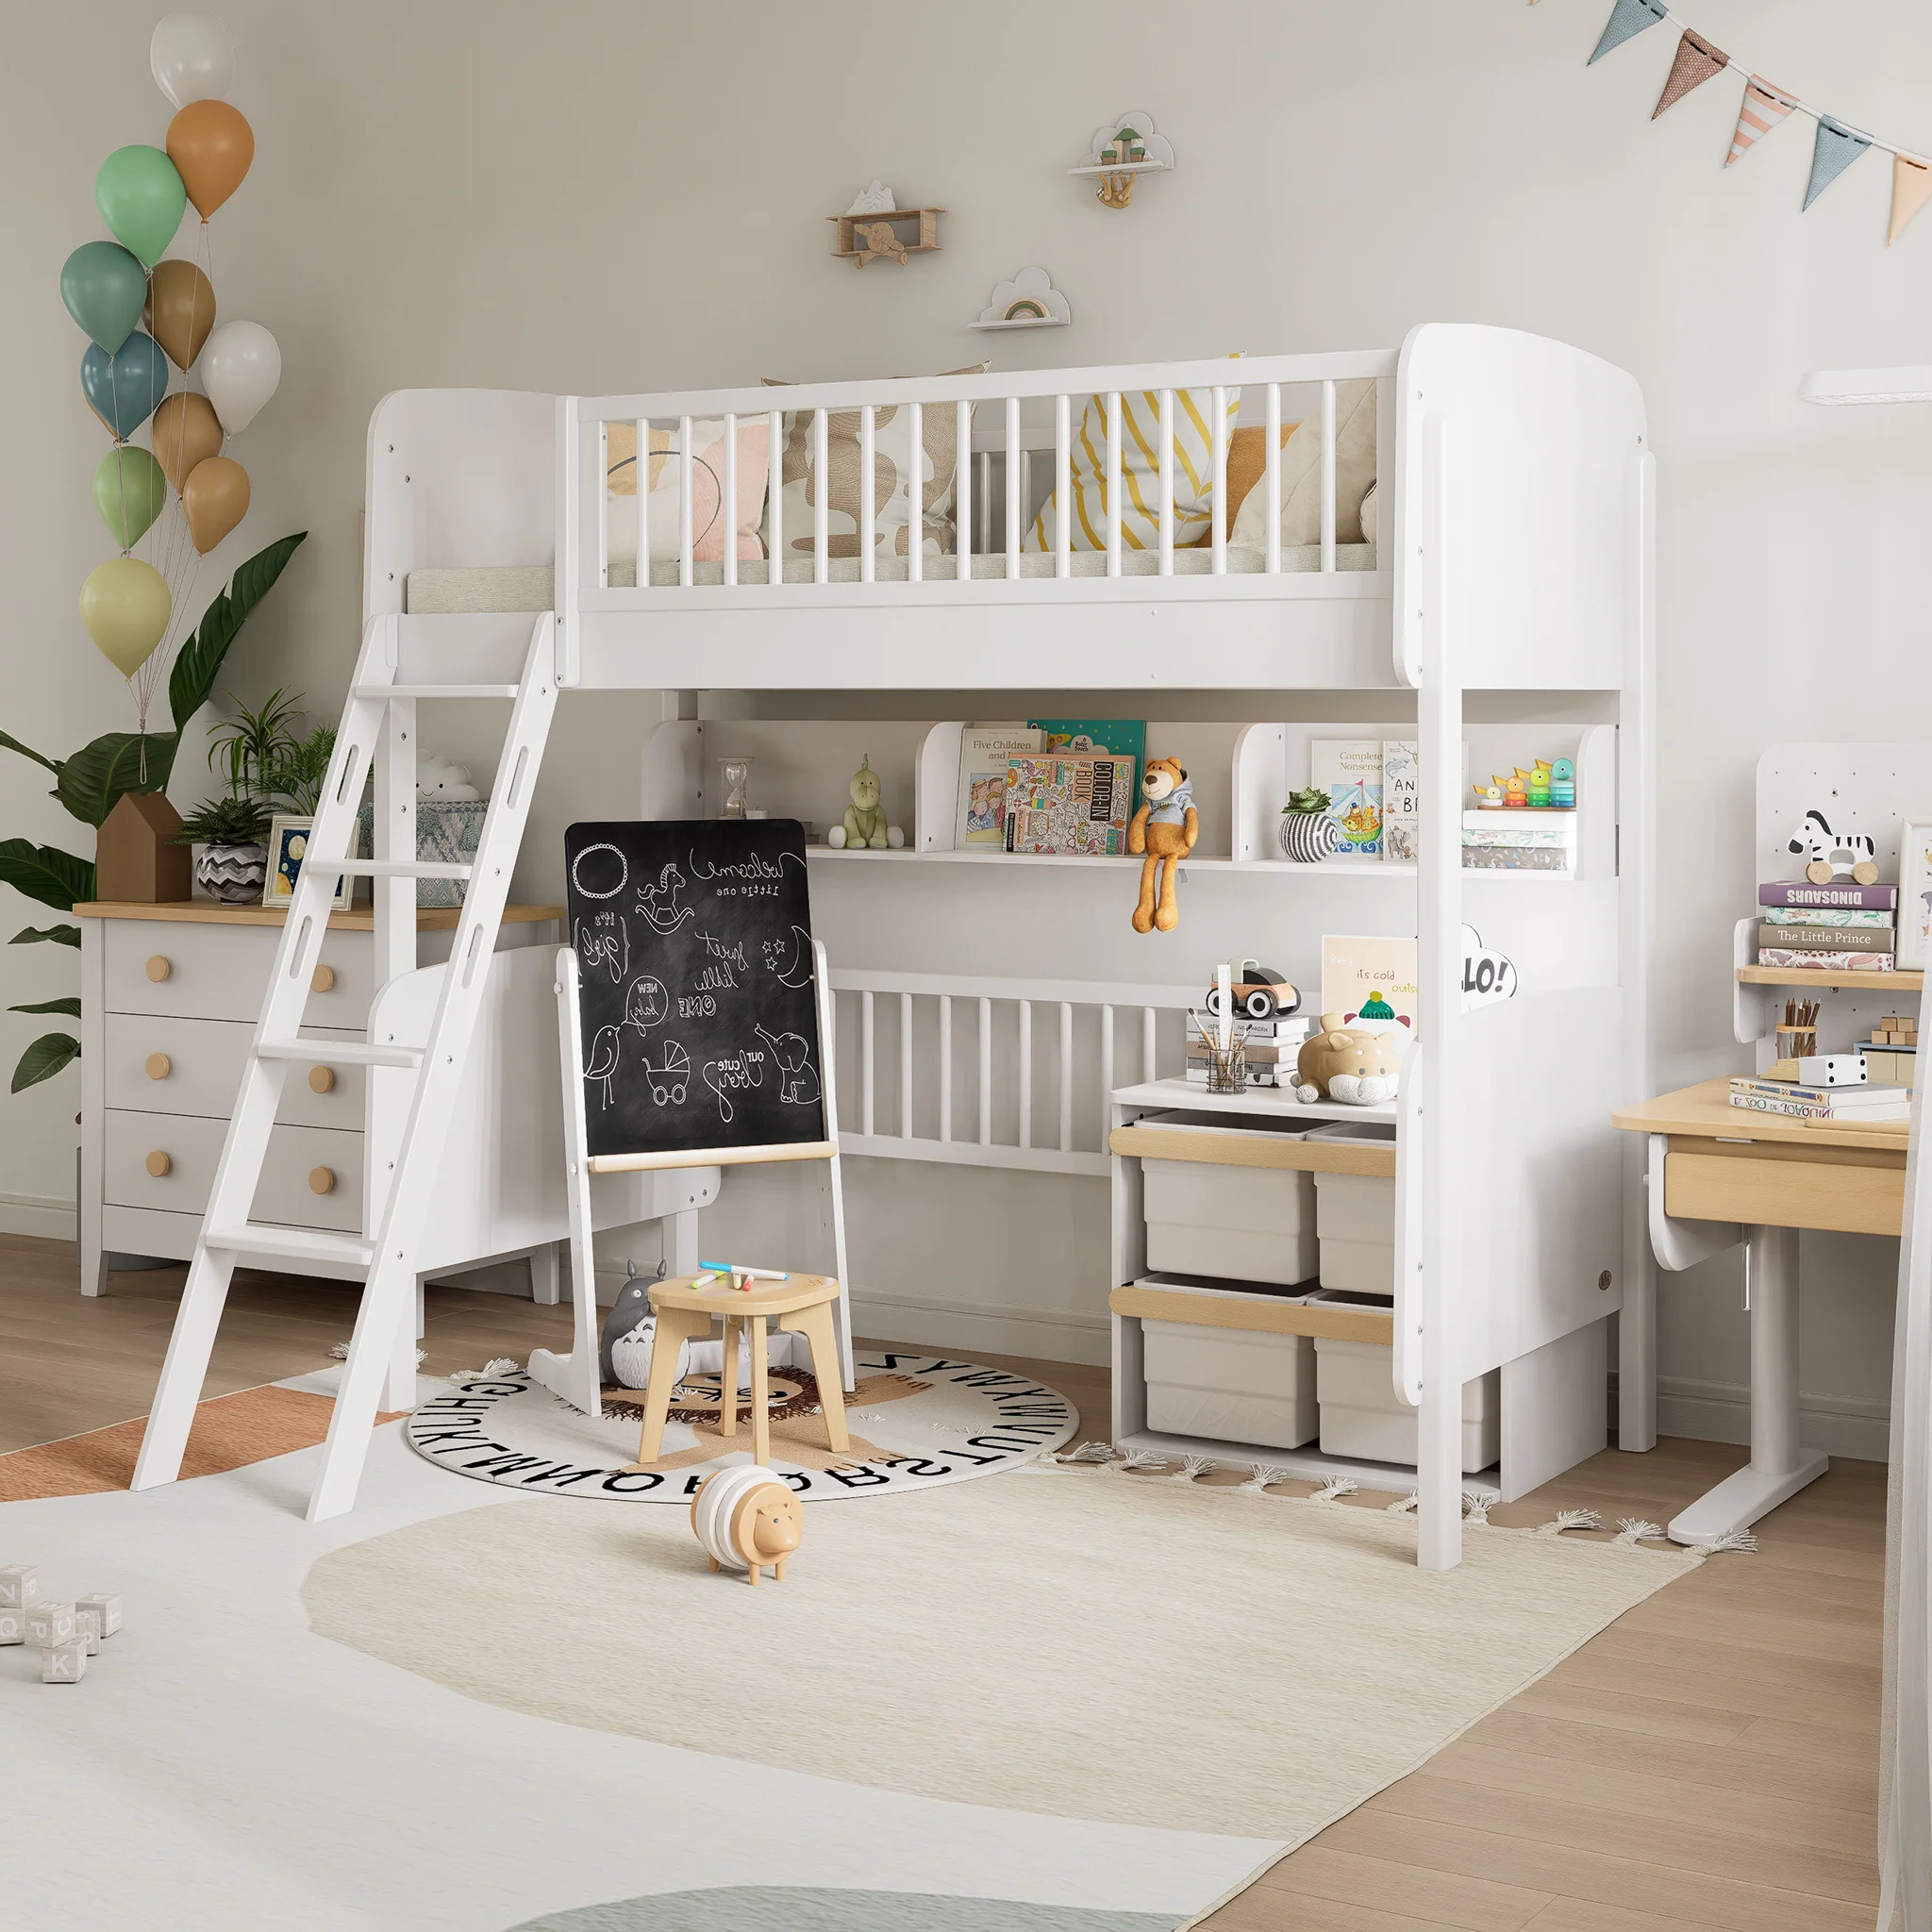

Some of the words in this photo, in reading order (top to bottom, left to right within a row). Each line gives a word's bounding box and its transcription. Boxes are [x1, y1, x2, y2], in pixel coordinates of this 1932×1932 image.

[974, 741, 991, 749] Five
[993, 741, 1032, 749] Children
[1340, 752, 1383, 762] Complete
[1340, 762, 1383, 771] Nonsense
[1074, 770, 1093, 801] BOOK
[1786, 889, 1862, 906] DINOSAURS
[1777, 930, 1798, 941] The
[1801, 931, 1832, 942] Little
[1835, 933, 1872, 944] Prince
[1374, 970, 1395, 980] cold
[1461, 957, 1508, 993] LO!
[0, 1617, 18, 1638] Q
[51, 1654, 70, 1675] K
